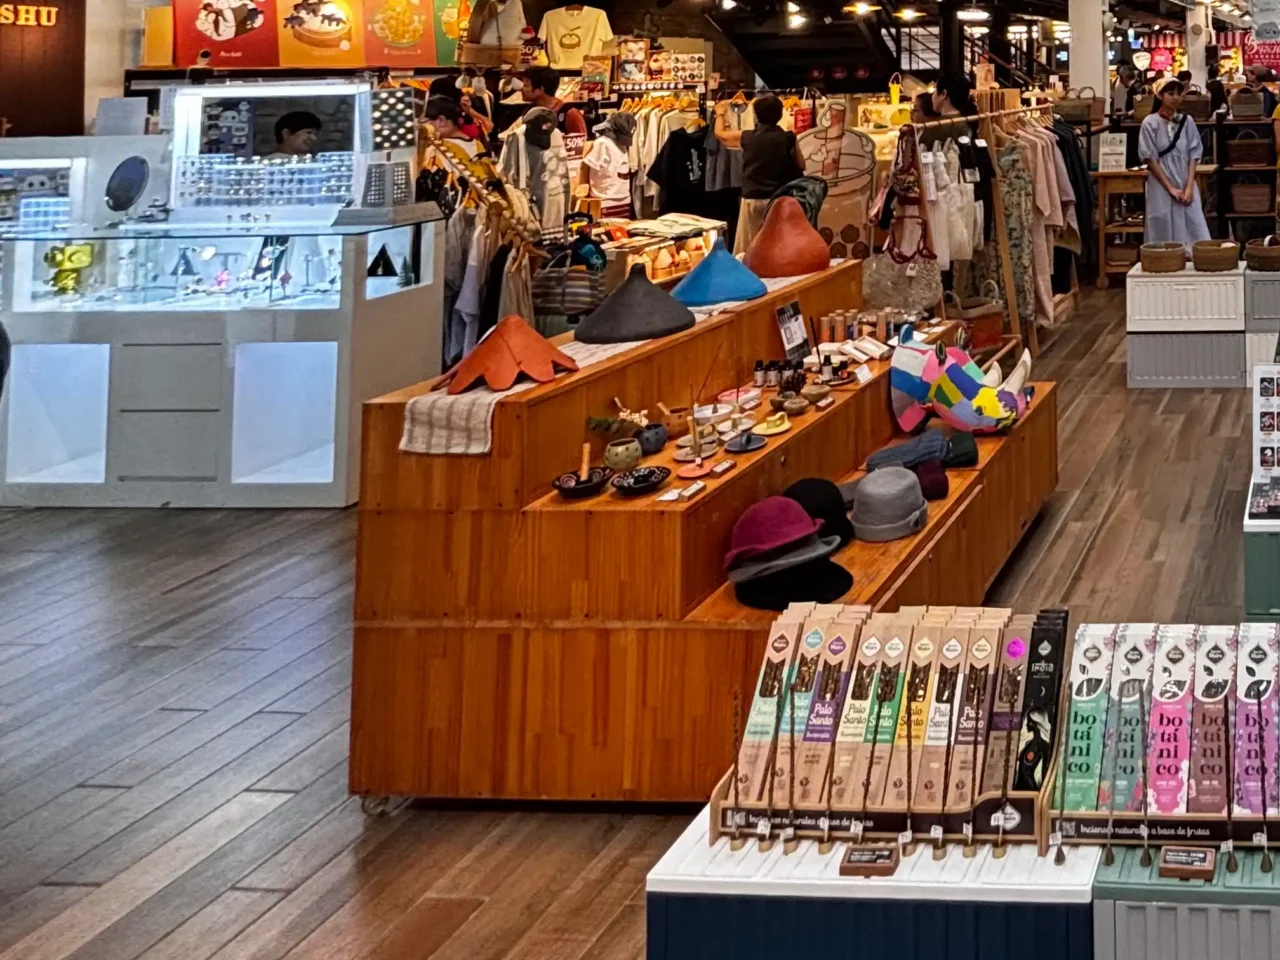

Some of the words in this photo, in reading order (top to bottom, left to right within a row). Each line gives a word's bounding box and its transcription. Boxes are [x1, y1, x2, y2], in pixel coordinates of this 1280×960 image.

[0, 4, 58, 26] SHU
[813, 704, 833, 714] Palo
[848, 704, 866, 714] Palo
[964, 707, 983, 717] Pao
[808, 714, 833, 725] Santo
[843, 715, 867, 725] Santo
[868, 716, 893, 726] Snto
[900, 717, 923, 727] Snto
[960, 717, 984, 728] Sano
[1072, 712, 1097, 725] bo
[1159, 713, 1183, 727] bo
[1201, 714, 1225, 728] bo
[1073, 726, 1092, 741] tá
[1160, 728, 1179, 743] tá
[1203, 727, 1222, 742] tá
[1071, 743, 1091, 757] ni
[1158, 745, 1178, 759] ni
[1202, 745, 1222, 758] ni
[1067, 762, 1090, 773] co
[1156, 763, 1179, 776] co
[1200, 763, 1223, 775] co
[1115, 826, 1150, 835] naturas
[1157, 826, 1175, 835] base
[1177, 826, 1186, 835] de
[1186, 826, 1211, 838] frutas
